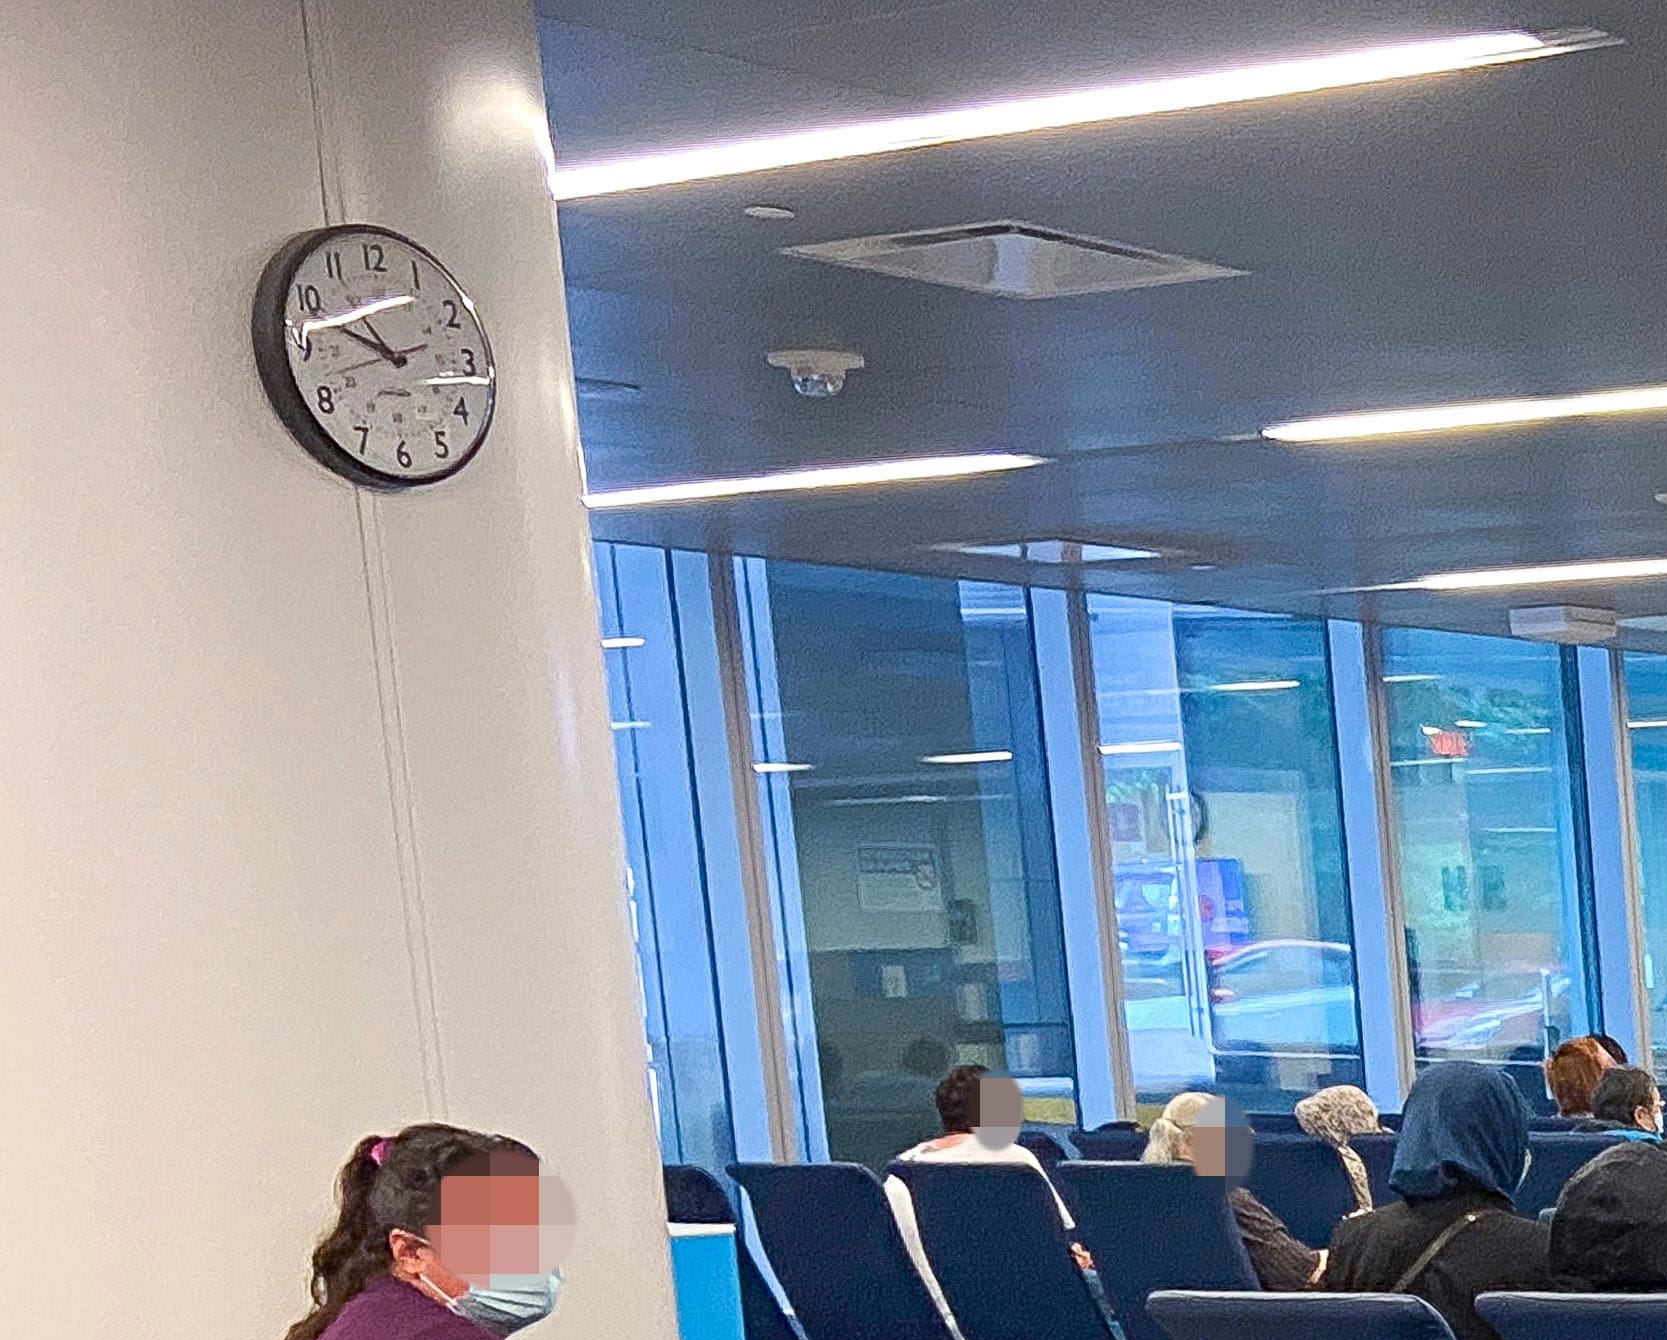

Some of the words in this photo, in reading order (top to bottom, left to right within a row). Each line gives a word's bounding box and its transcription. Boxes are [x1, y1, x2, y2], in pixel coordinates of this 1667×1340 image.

[325, 252, 343, 280] 11
[361, 243, 387, 272] 12
[411, 260, 420, 290] 1
[296, 283, 321, 312] 10
[442, 300, 461, 329] 2
[460, 348, 476, 376] 3
[317, 385, 335, 415] 8
[453, 396, 469, 426] 4
[353, 425, 369, 455] 7
[396, 440, 412, 468] 6
[434, 430, 449, 459] 5
